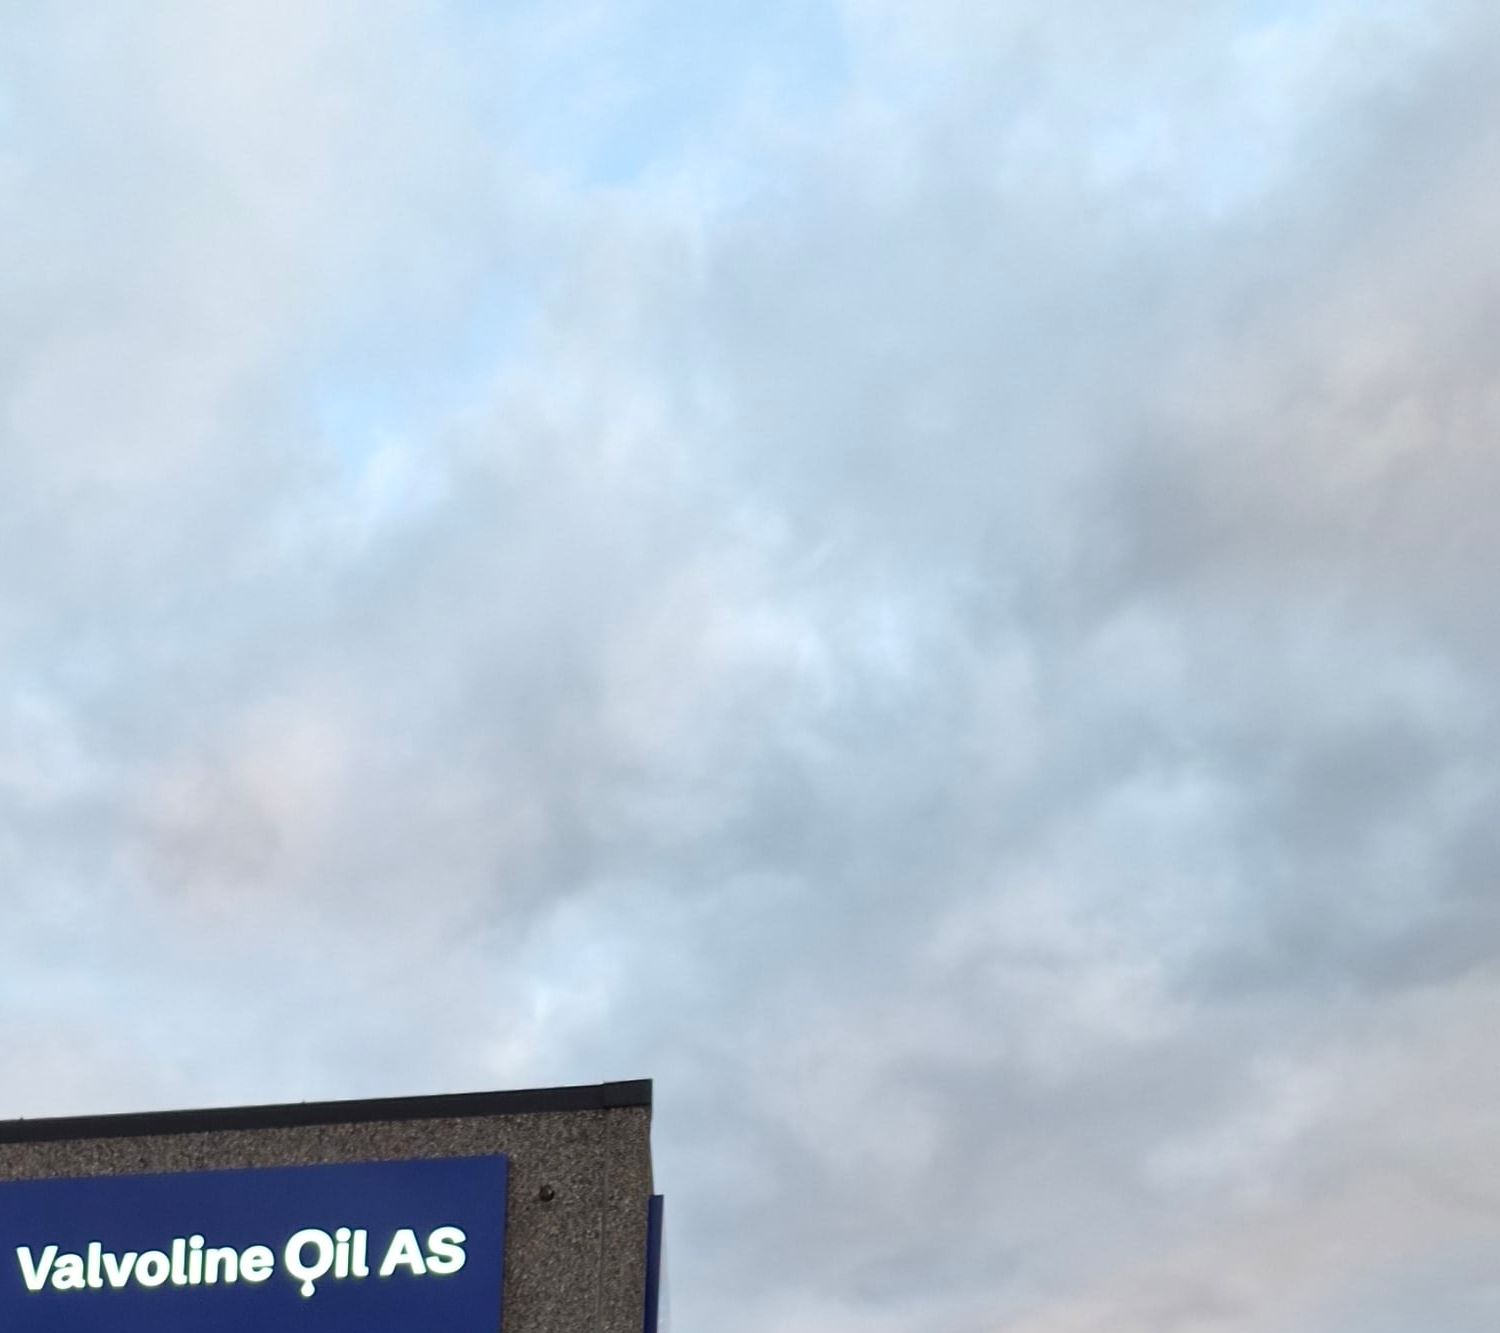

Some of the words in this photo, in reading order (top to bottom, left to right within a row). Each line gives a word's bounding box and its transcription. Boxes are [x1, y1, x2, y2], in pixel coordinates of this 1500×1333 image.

[16, 1234, 274, 1291] Valvoline
[284, 1227, 369, 1297] Oil
[380, 1226, 467, 1275] AS
